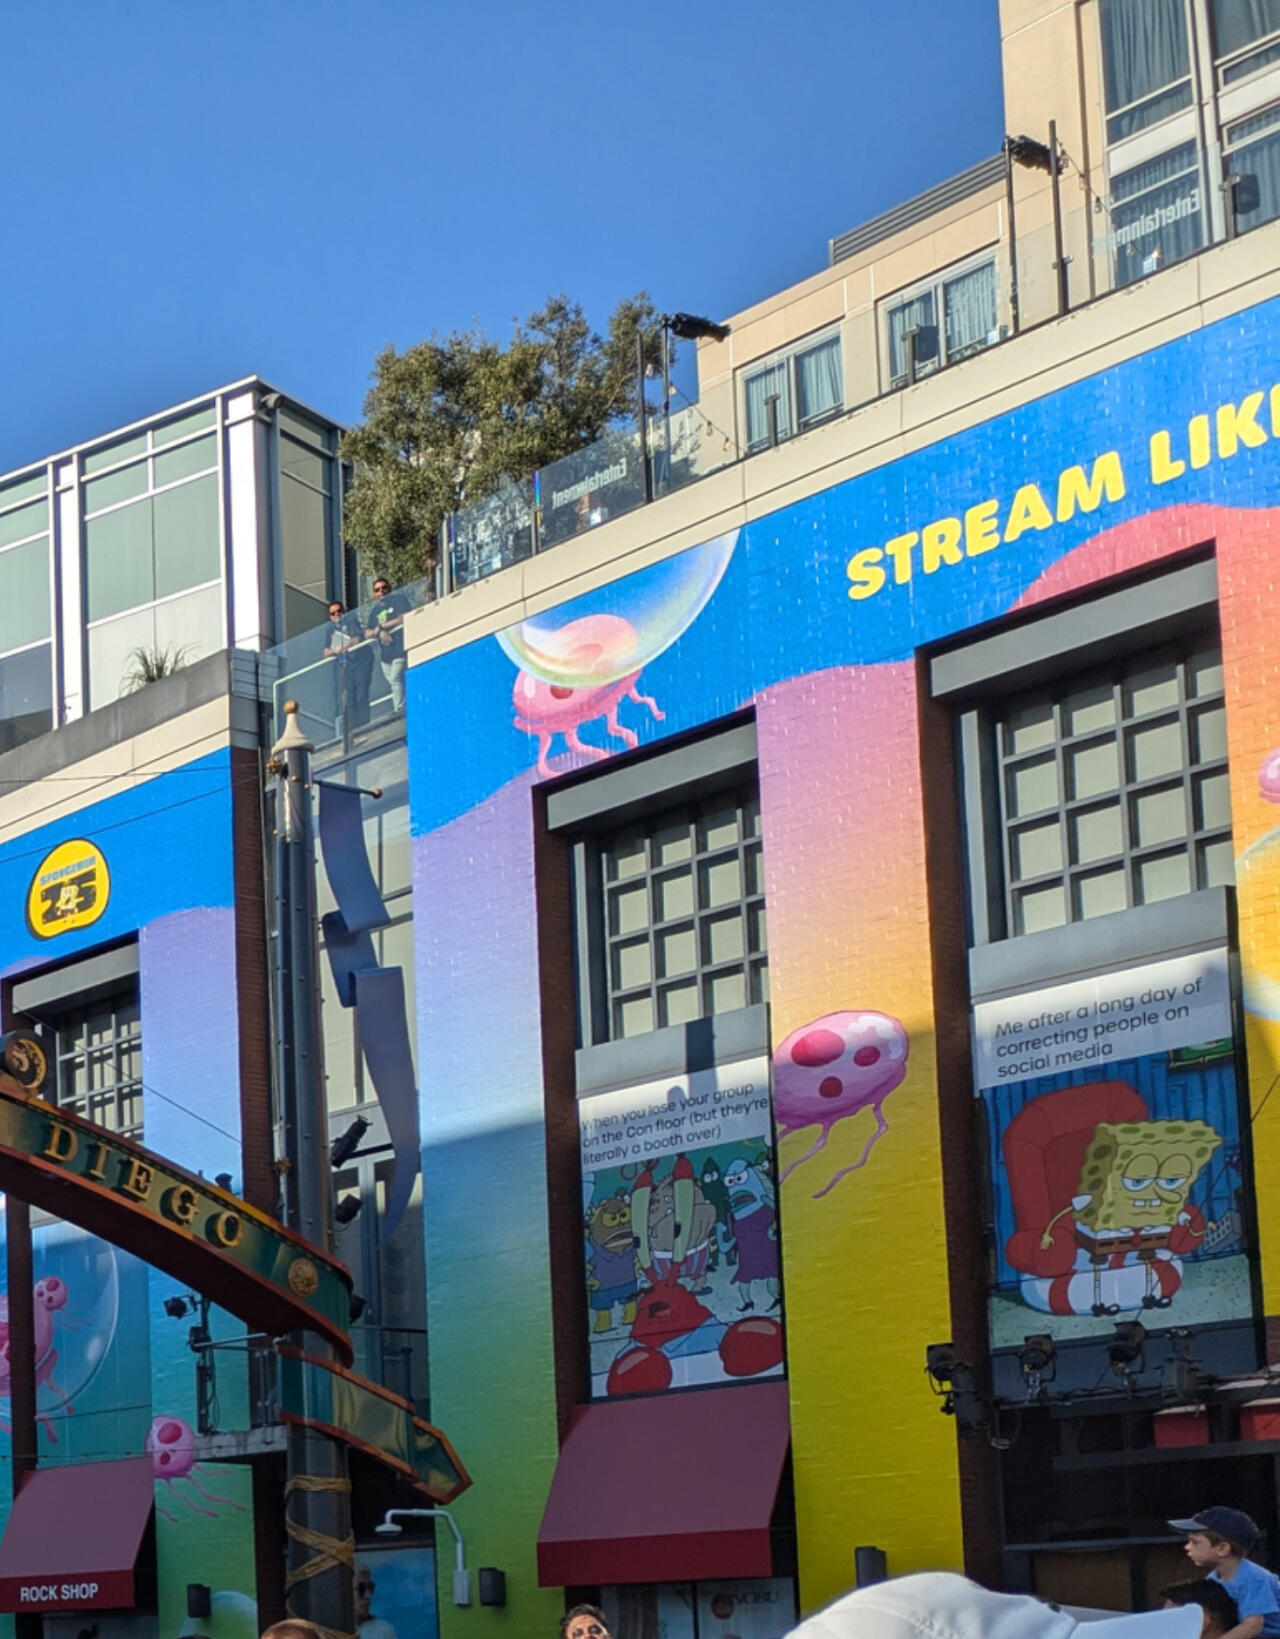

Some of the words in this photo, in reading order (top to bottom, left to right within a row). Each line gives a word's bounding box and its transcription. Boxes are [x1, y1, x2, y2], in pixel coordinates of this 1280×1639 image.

[846, 451, 1126, 600] STREAM
[994, 1022, 1024, 1038] Me
[1028, 1008, 1072, 1030] after
[1076, 1005, 1089, 1018] a
[1093, 995, 1135, 1016] long
[1140, 984, 1178, 1006] day
[1183, 976, 1203, 995] of
[996, 1025, 1089, 1058] correcting
[1093, 1012, 1160, 1039] people
[1164, 1004, 1190, 1021] on
[997, 1056, 1050, 1079] social
[1054, 1041, 1113, 1067] media
[581, 1114, 620, 1131] When
[622, 1108, 647, 1125] you
[648, 1101, 676, 1117] lose
[679, 1093, 710, 1112] your
[712, 1083, 755, 1103] group
[583, 1136, 600, 1149] on
[601, 1129, 624, 1144] the
[626, 1124, 654, 1139] Con
[655, 1115, 688, 1133] floor
[689, 1108, 718, 1128] (but
[720, 1097, 769, 1117] they're
[583, 1145, 630, 1166] literally
[631, 1143, 642, 1155] a
[643, 1134, 684, 1152] booth
[686, 1124, 722, 1143] over)
[43, 1121, 246, 1247] DIEGO
[20, 1584, 58, 1602] ROCK
[60, 1582, 99, 1600] SHOP
